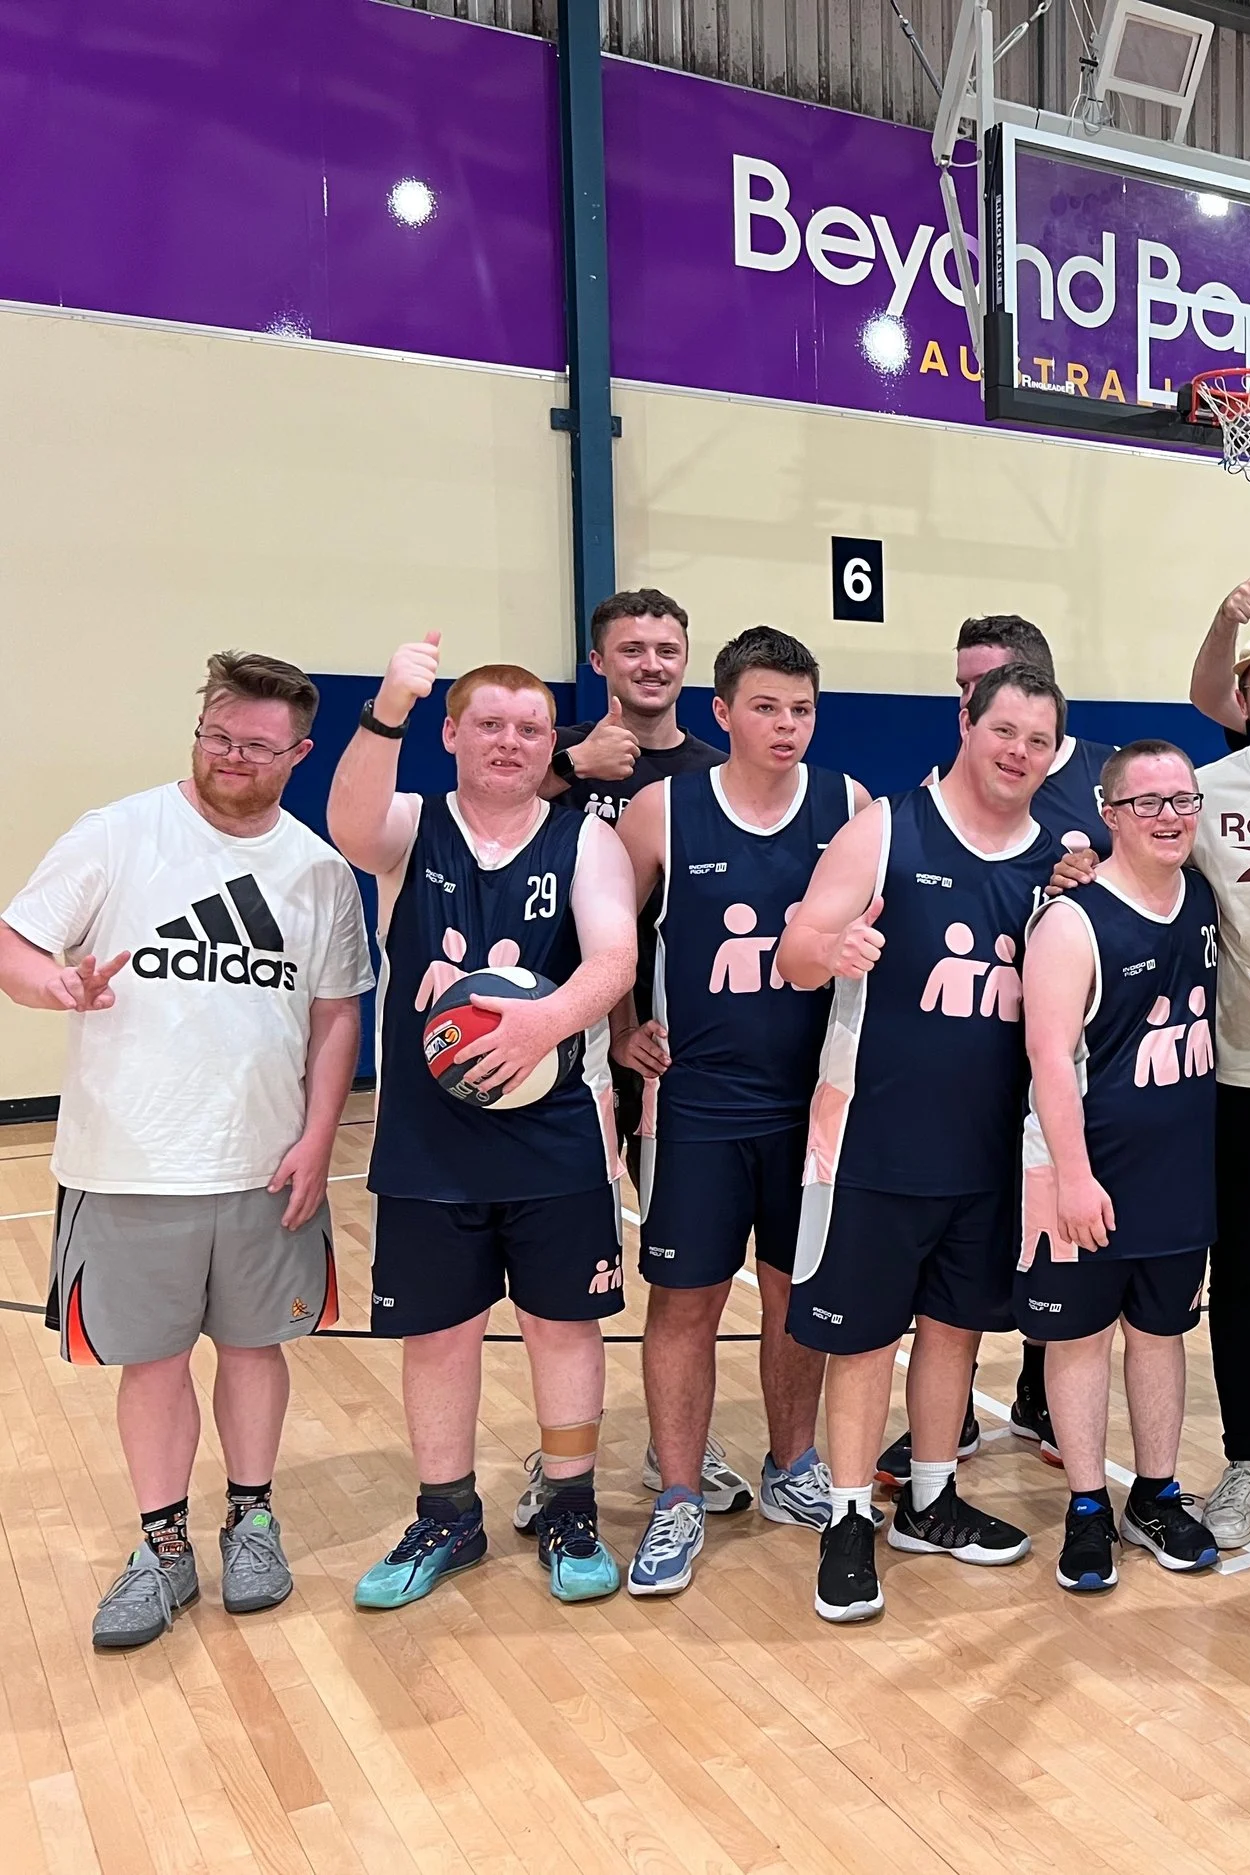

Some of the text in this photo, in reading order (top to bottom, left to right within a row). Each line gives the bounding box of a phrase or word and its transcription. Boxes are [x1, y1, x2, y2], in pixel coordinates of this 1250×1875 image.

[733, 154, 1116, 329] Beyond
[919, 340, 1173, 410] AUTRAI
[843, 557, 872, 602] 6
[524, 872, 557, 921] 29
[132, 941, 298, 991] adidas
[1200, 924, 1218, 969] 26
